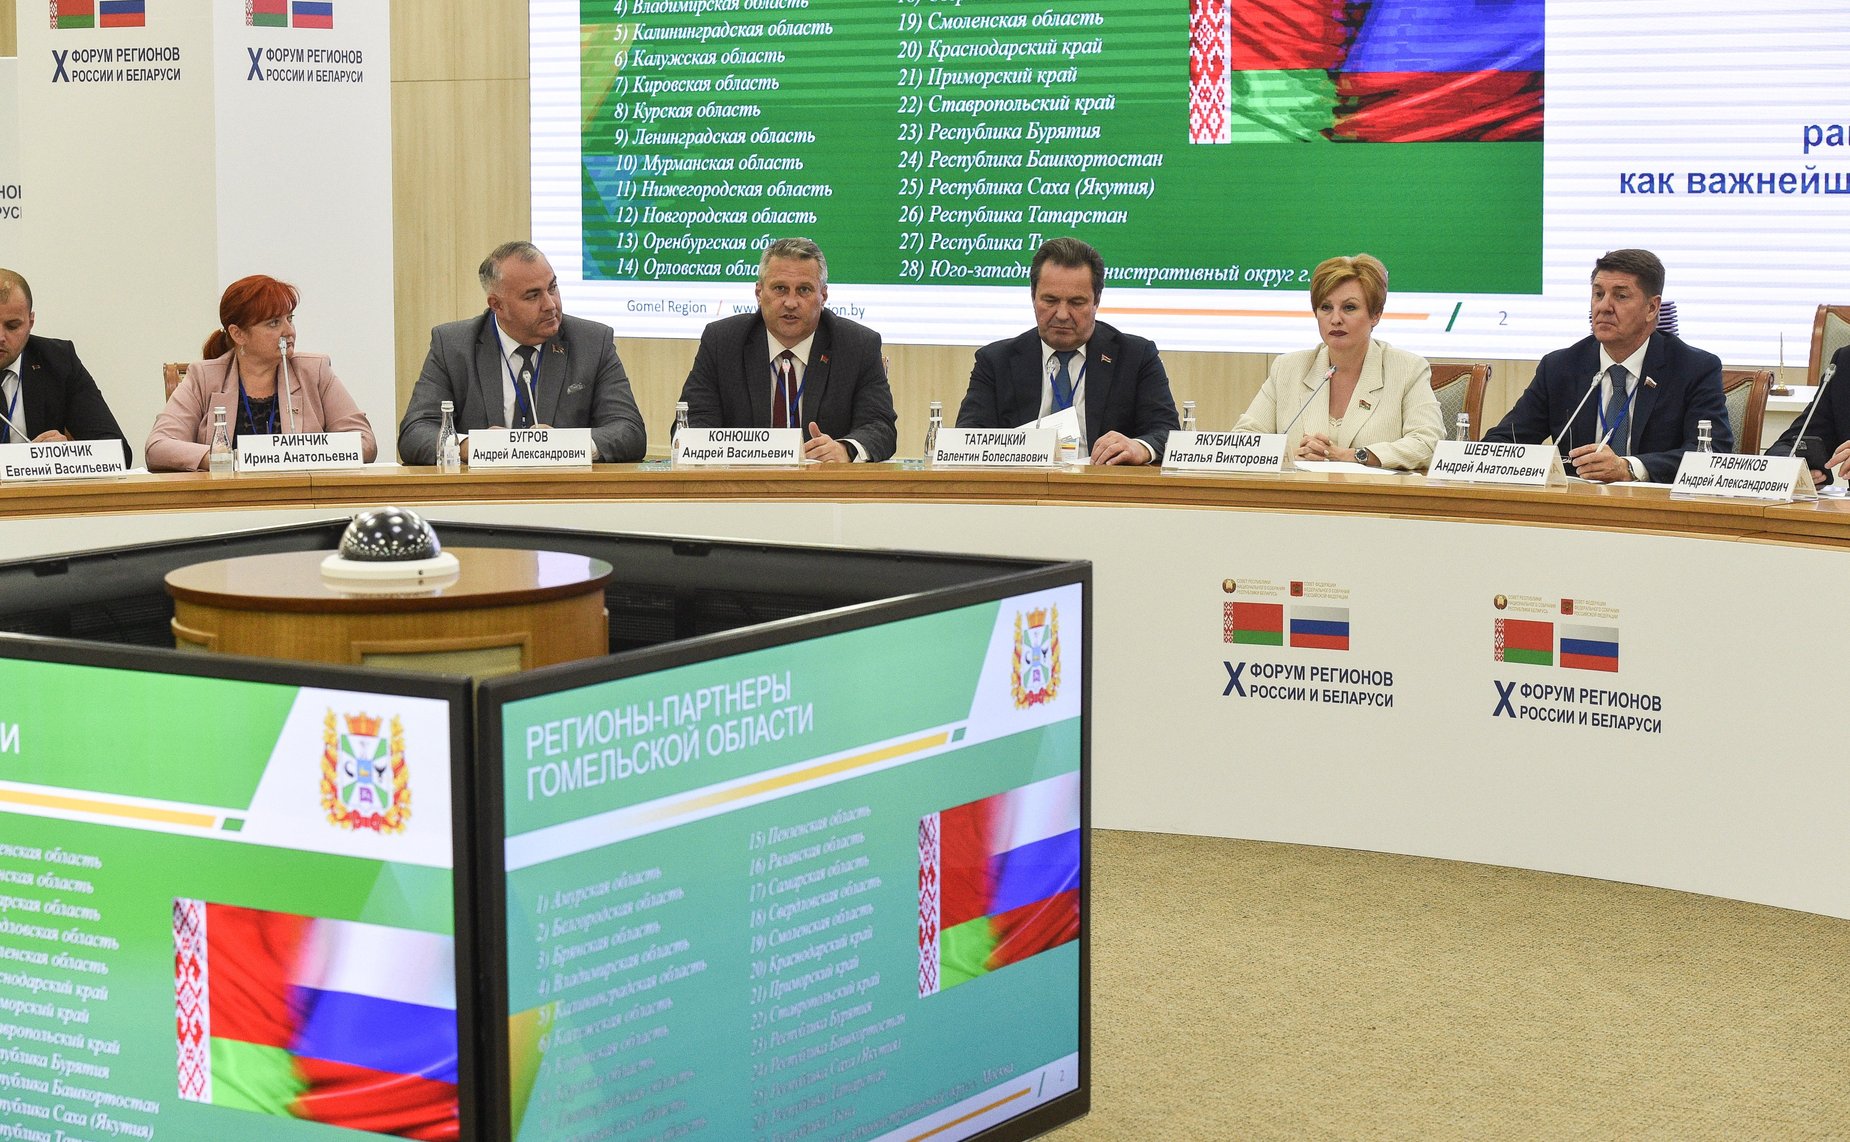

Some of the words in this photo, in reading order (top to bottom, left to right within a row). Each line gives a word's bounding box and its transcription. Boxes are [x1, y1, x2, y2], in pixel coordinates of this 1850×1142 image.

[614, 24, 628, 42] 5)
[633, 21, 764, 43] Калининградская
[768, 19, 833, 36] область
[898, 12, 922, 33] 19)
[927, 11, 1027, 30] Смоленская
[1032, 9, 1104, 27] область
[72, 48, 114, 64] ФОРУМ
[116, 46, 181, 62] РЕГИОНОВ
[266, 47, 304, 64] ФОРУМ
[307, 49, 363, 65] РЕГИОНОВ
[614, 52, 628, 70] 6)
[632, 49, 717, 71] Калужская
[721, 47, 785, 64] область
[897, 41, 923, 61] 20)
[927, 38, 1058, 62] Краснодарский
[1061, 37, 1103, 59] край
[72, 68, 114, 83] РОССИИ
[116, 68, 124, 82] И
[126, 67, 181, 82] БЕЛАРУСИ
[266, 68, 305, 82] РОССИИ
[307, 69, 314, 83] И
[315, 69, 364, 84] БЕЛАРУСИ
[614, 77, 628, 96] 7)
[633, 75, 711, 97] Кировская
[715, 74, 780, 91] область
[898, 69, 923, 89] 21)
[927, 67, 1032, 90] Приморский
[1036, 66, 1078, 88] край
[614, 104, 629, 123] 8)
[633, 102, 693, 123] Курская
[697, 101, 761, 118] область
[898, 96, 923, 117] 22)
[928, 94, 1070, 117] Ставропольский
[1074, 94, 1116, 115] край
[615, 130, 629, 149] 9)
[632, 127, 746, 149] Ленинградская
[750, 128, 816, 144] область
[898, 124, 923, 144] 23)
[927, 122, 1022, 144] Республика
[1026, 121, 1101, 144] Бурятия
[1804, 124, 1850, 154] ра
[616, 155, 638, 175] 10)
[642, 154, 734, 175] Мурманская
[738, 153, 804, 170] область
[898, 151, 924, 171] 24)
[927, 150, 1022, 172] Республика
[1026, 149, 1163, 172] Башкортостан
[616, 181, 637, 201] 11)
[641, 180, 763, 202] Нижегородская
[767, 179, 833, 197] область
[898, 178, 924, 199] 25)
[928, 178, 1023, 199] Республика
[1027, 177, 1070, 195] Саха
[1074, 177, 1155, 200] (Якутия)
[1620, 172, 1675, 194] как
[616, 207, 639, 227] 12)
[642, 206, 747, 228] Новгородская
[751, 207, 817, 224] область
[898, 206, 924, 226] 26)
[928, 205, 1023, 227] Республика
[1028, 206, 1128, 227] Татарстан
[617, 233, 639, 253] 13)
[643, 232, 747, 254] Оренбургская
[899, 233, 924, 253] 27)
[929, 233, 1023, 254] Республика
[617, 258, 639, 278] 14)
[644, 258, 721, 280] Орловская
[726, 259, 759, 276] обла
[899, 261, 925, 281] 28)
[929, 260, 1031, 280] Юго-западн
[1244, 266, 1294, 287] округ
[1298, 269, 1311, 282] г.
[627, 300, 664, 313] Gomel
[668, 300, 707, 316] Region
[1498, 310, 1508, 326] 2
[509, 430, 548, 443] БУГРОВ
[708, 430, 770, 442] КОНЮШКО
[964, 431, 1026, 447] ТАТАРИЦКИЙ
[1195, 433, 1261, 449] ЯКУБИЦКАЯ
[30, 444, 93, 460] БУЛОЙЧИК
[244, 452, 280, 466] Ирина
[283, 451, 359, 463] Анатольевна
[473, 446, 510, 461] Андрей
[512, 446, 586, 461] Александрович
[682, 446, 724, 461] Андрей
[726, 446, 794, 460] Васильевич
[937, 450, 979, 463] Валентин
[982, 450, 1049, 464] Болеславович
[1169, 450, 1212, 465] Наталья
[1215, 451, 1279, 466] Викторовна
[1463, 443, 1526, 459] ШЕВЧЕНКО
[5, 462, 52, 478] Евгений
[54, 461, 122, 476] Васильевич
[1434, 458, 1474, 476] Андрей
[1475, 461, 1546, 479] Анатольевич
[1709, 455, 1768, 472] ТРАВНИКОВ
[1678, 472, 1714, 488] Андрей
[1715, 475, 1790, 494] Александрович
[1250, 662, 1305, 681] ФОРУМ
[1310, 667, 1394, 687] РЕГИОНОВ
[1250, 684, 1306, 701] РОССИИ
[1310, 688, 1318, 702] И
[1322, 689, 1393, 708] БЕЛАРУСИ
[1520, 683, 1575, 703] ФОРУМ
[1579, 688, 1662, 712] РЕГИОНОВ
[526, 670, 791, 760] РЕГИОНЫ-ПАРТНЕРЫ
[1520, 705, 1575, 724] РОССИИ
[1579, 711, 1588, 726] И
[1591, 712, 1662, 734] БЕЛАРУСИ
[527, 723, 700, 801] ГОМЕЛЬСКОЙ
[706, 703, 814, 757] ОБЛАСТИ
